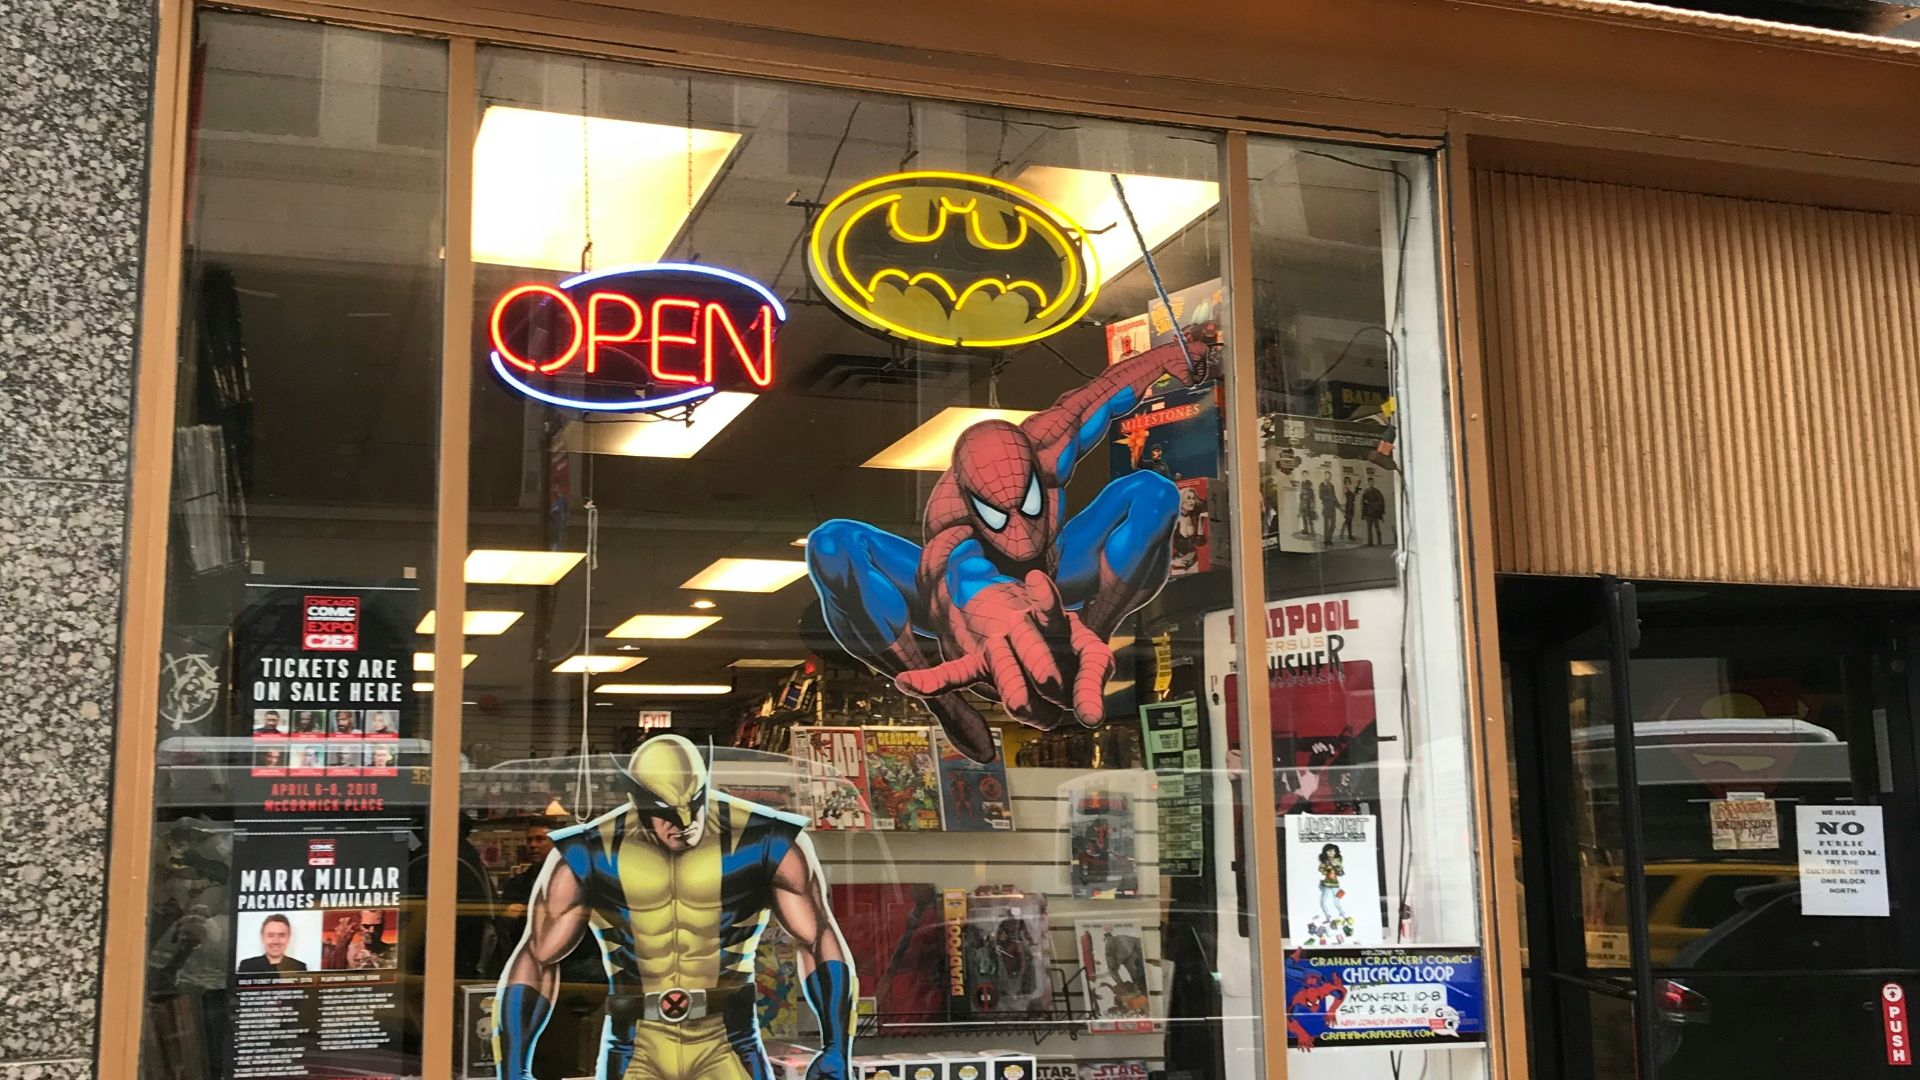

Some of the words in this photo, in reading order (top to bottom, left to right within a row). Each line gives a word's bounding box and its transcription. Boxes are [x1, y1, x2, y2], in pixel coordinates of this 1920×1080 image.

[490, 284, 774, 388] OPEN
[1121, 403, 1200, 431] MILESTONES
[307, 606, 356, 616] COMIC
[308, 621, 355, 632] EXPO
[305, 634, 355, 648] C2E2
[1266, 636, 1325, 653] ERSUS
[260, 657, 349, 678] TICKETS
[357, 659, 397, 679] ARE
[253, 681, 280, 702] ON
[290, 682, 340, 702] SALE
[350, 682, 402, 702] HERE
[643, 714, 668, 727] EXIT
[271, 783, 310, 796] APRIL
[347, 783, 378, 796] 2018
[344, 798, 385, 811] PLACE
[1815, 821, 1865, 835] NO
[240, 869, 305, 892] MARK
[315, 867, 400, 890] MILLAR
[238, 893, 315, 909] PACKAGES
[320, 891, 401, 908] AVAILABLE
[947, 916, 965, 996] DEADPOOL
[1309, 956, 1362, 967] GRAHAM
[1364, 955, 1423, 966] CRACKERS
[1426, 955, 1473, 964] COMICS
[1342, 967, 1412, 983] CHICAGO
[1415, 966, 1455, 982] LOOP
[1415, 991, 1442, 1001] 10-8
[1339, 1005, 1363, 1014] SAT
[1369, 1005, 1375, 1014] &
[1888, 1006, 1906, 1062] PUSH
[1092, 1063, 1148, 1077] STAR
